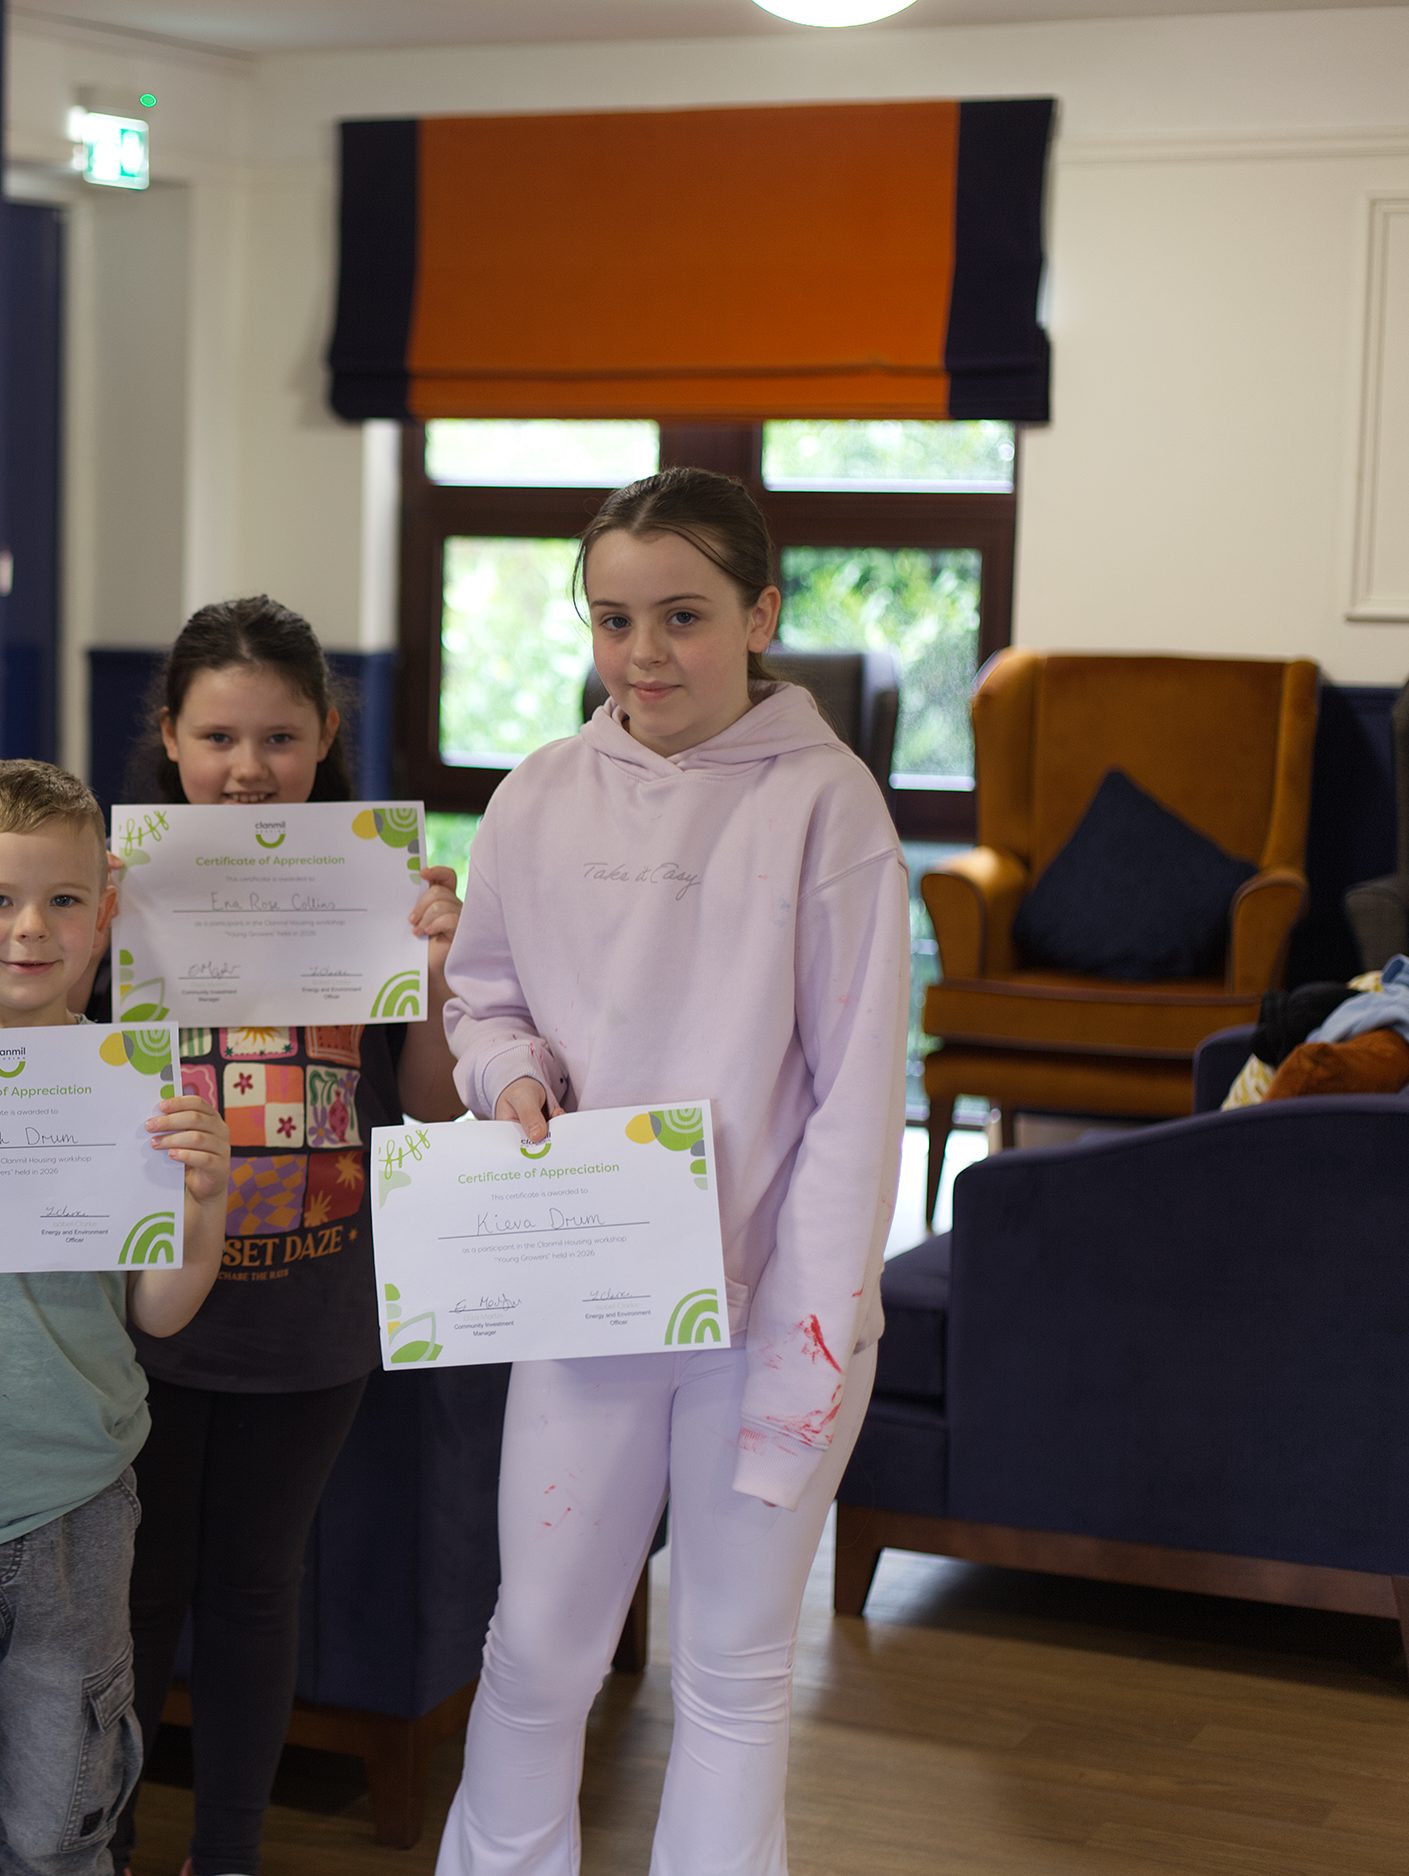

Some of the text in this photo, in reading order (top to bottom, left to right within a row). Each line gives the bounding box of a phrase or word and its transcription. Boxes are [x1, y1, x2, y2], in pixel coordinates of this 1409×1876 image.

[255, 821, 286, 829] clanmil
[196, 855, 345, 867] Certificate of Appreciation
[584, 862, 701, 901] Take it Easy
[249, 892, 280, 911] Rose
[292, 893, 335, 911] Collins
[11, 1084, 92, 1099] Appreciation
[25, 1126, 78, 1145] Drum
[29, 1155, 56, 1164] Housing
[58, 1155, 92, 1164] workshop
[458, 1163, 620, 1184] Certificate of Appreciation
[491, 1192, 504, 1200] This
[505, 1190, 539, 1199] certificate
[548, 1187, 579, 1196] awarded
[477, 1207, 605, 1236] Kieva Drum
[223, 1225, 343, 1267] SET DAZE
[478, 1243, 515, 1254] participant
[537, 1240, 563, 1248] Clanmil
[565, 1238, 592, 1248] Housing
[594, 1235, 627, 1246] workshop
[251, 1270, 268, 1281] THE
